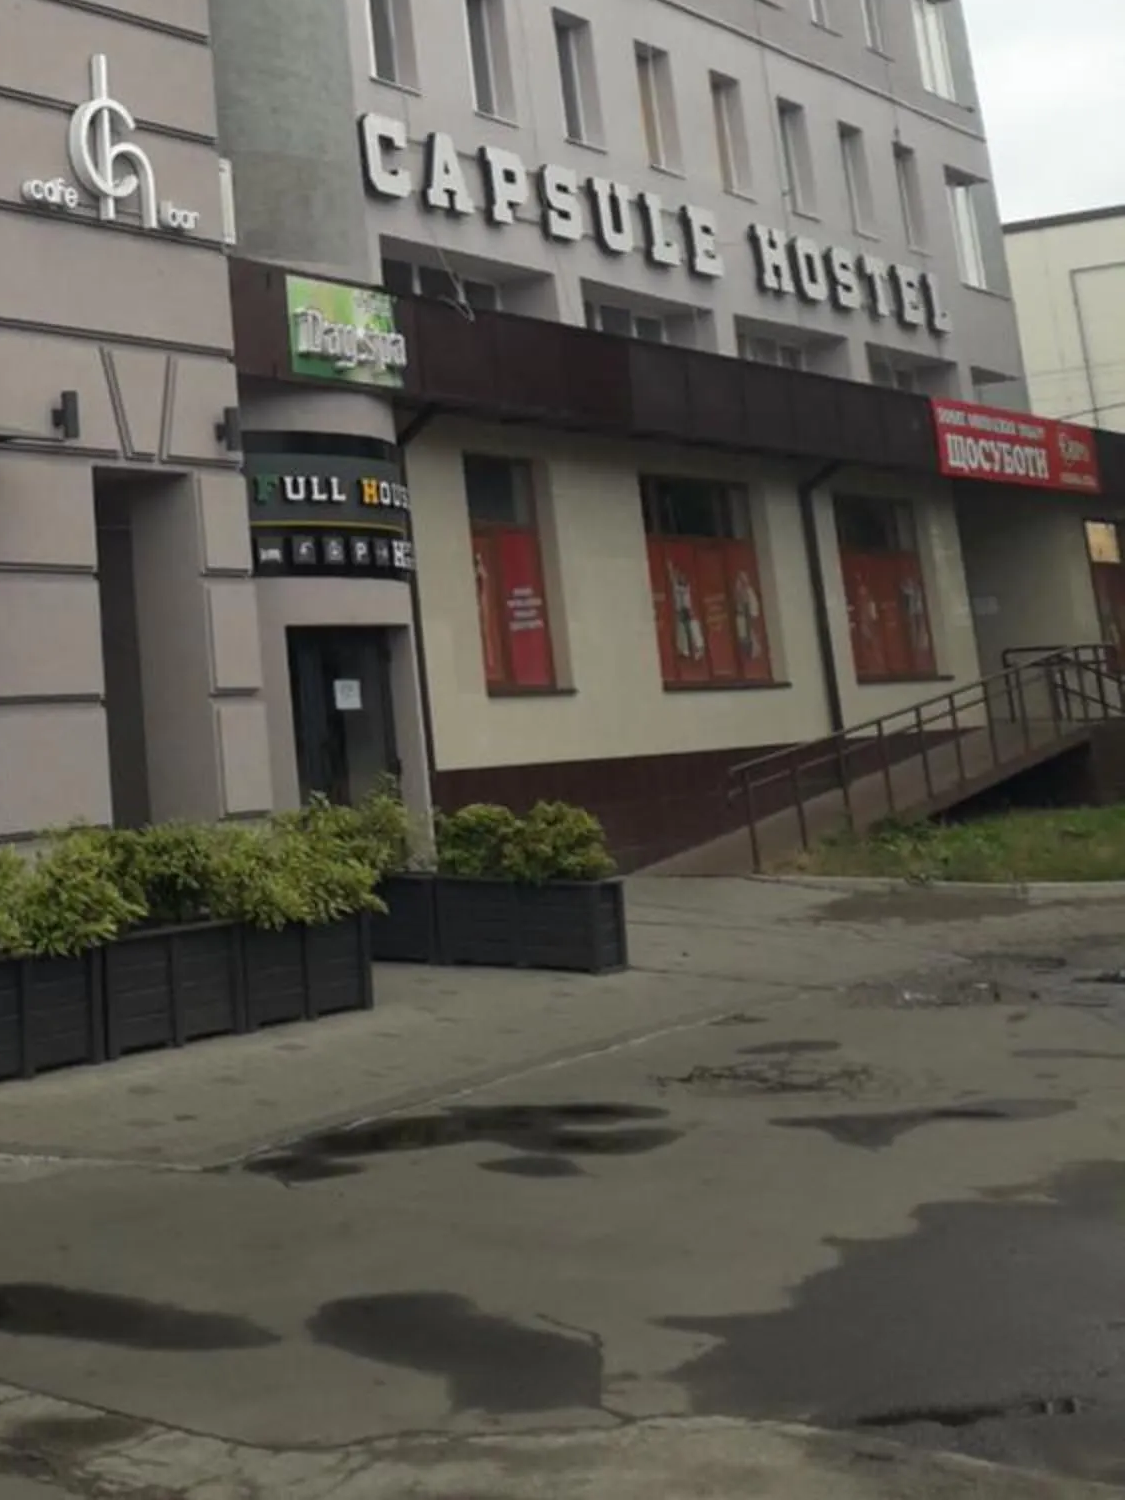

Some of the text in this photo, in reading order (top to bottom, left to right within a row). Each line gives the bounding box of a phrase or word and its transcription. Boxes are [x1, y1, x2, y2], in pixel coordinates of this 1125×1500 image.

[23, 176, 79, 208] cafe
[357, 112, 724, 278] CAPSULE
[160, 201, 200, 230] bar
[748, 223, 952, 334] HOSTEL
[945, 433, 1050, 481] ЩОСУБОТИ
[254, 472, 348, 503] FULL
